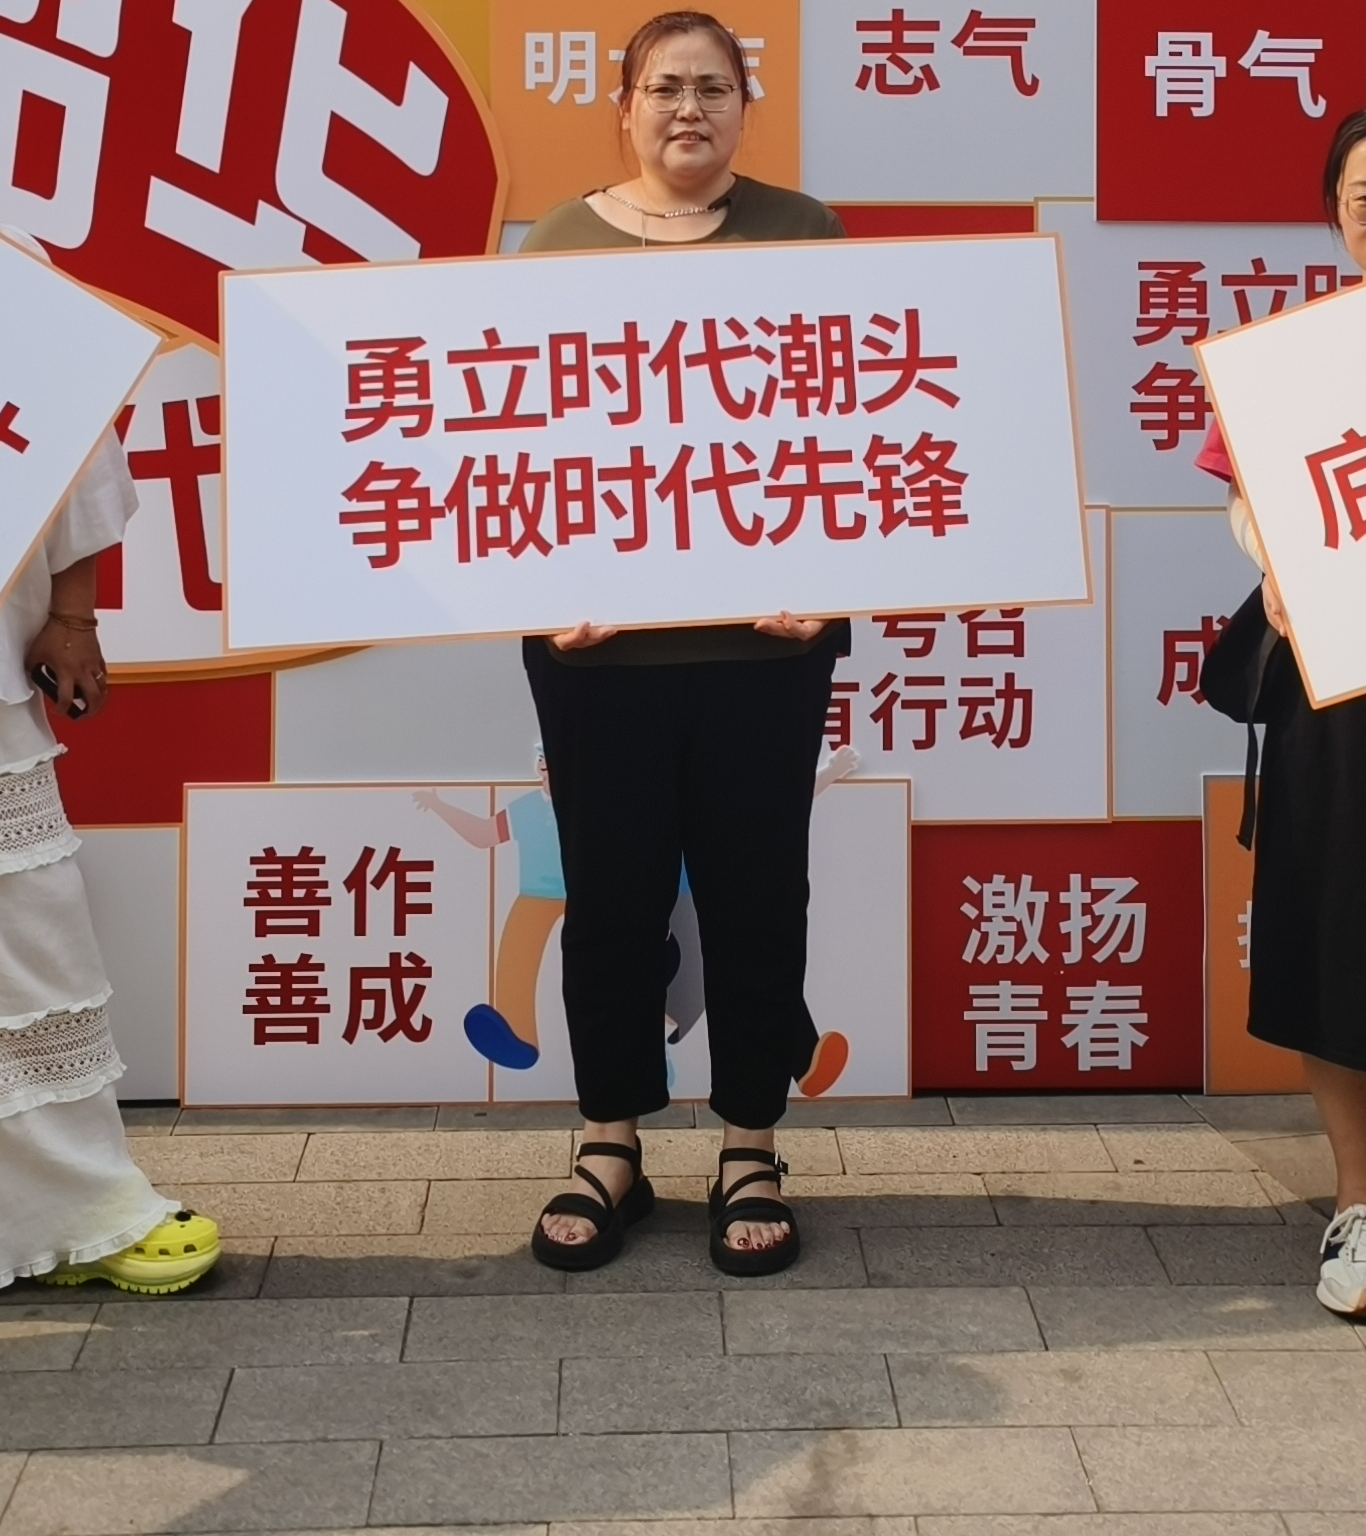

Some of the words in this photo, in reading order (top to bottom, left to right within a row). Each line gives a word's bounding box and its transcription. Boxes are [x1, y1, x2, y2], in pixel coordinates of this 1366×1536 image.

[854, 8, 1040, 97] 志气
[1144, 29, 1327, 119] 骨气
[340, 308, 961, 443] 勇立时代潮头
[338, 431, 970, 570] 争做时代先锋
[242, 845, 435, 938] 善作
[960, 872, 1149, 965] 激扬
[241, 951, 434, 1046] 善成
[962, 979, 1150, 1071] 青春
